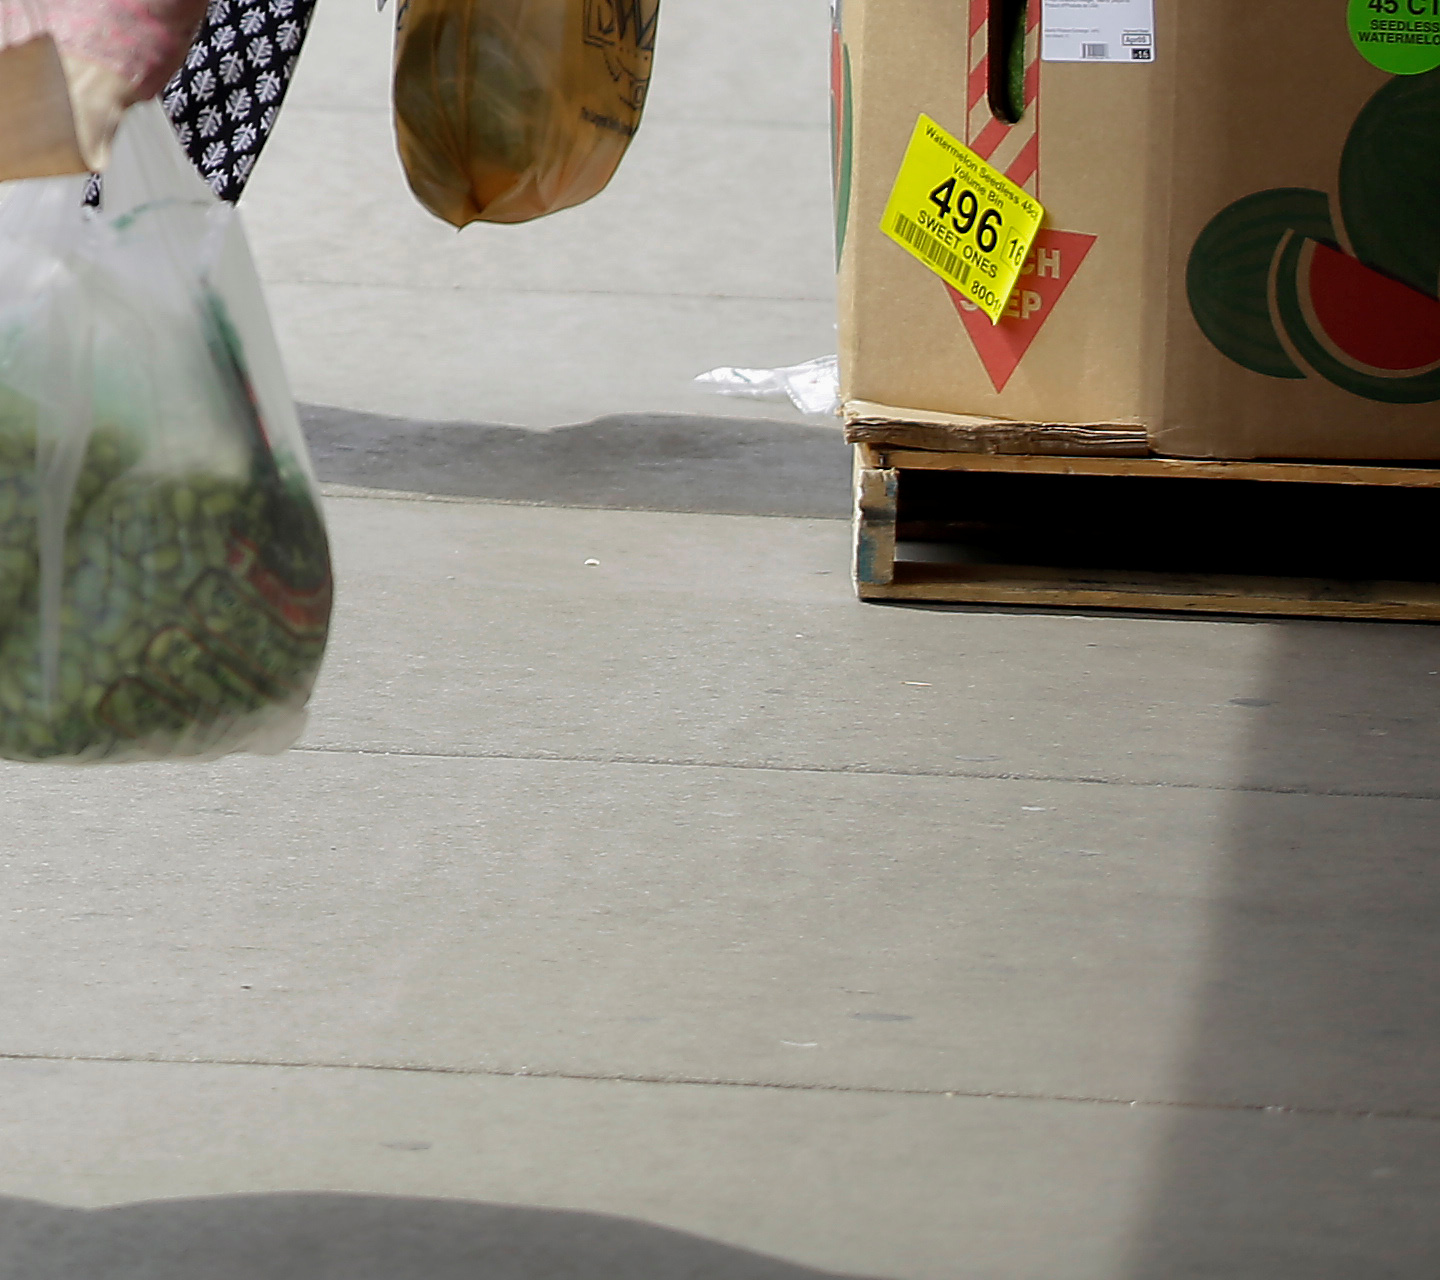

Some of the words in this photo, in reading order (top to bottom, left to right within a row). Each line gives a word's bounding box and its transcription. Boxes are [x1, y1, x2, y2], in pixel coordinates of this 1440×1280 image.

[926, 125, 978, 172] Watermelon
[979, 166, 1020, 204] Seedless
[953, 162, 987, 196] Volume
[987, 190, 1005, 209] Bin
[916, 209, 963, 251] SWEET
[962, 244, 998, 279] ONES
[929, 176, 1002, 254] 496
[1008, 238, 1025, 267] 16
